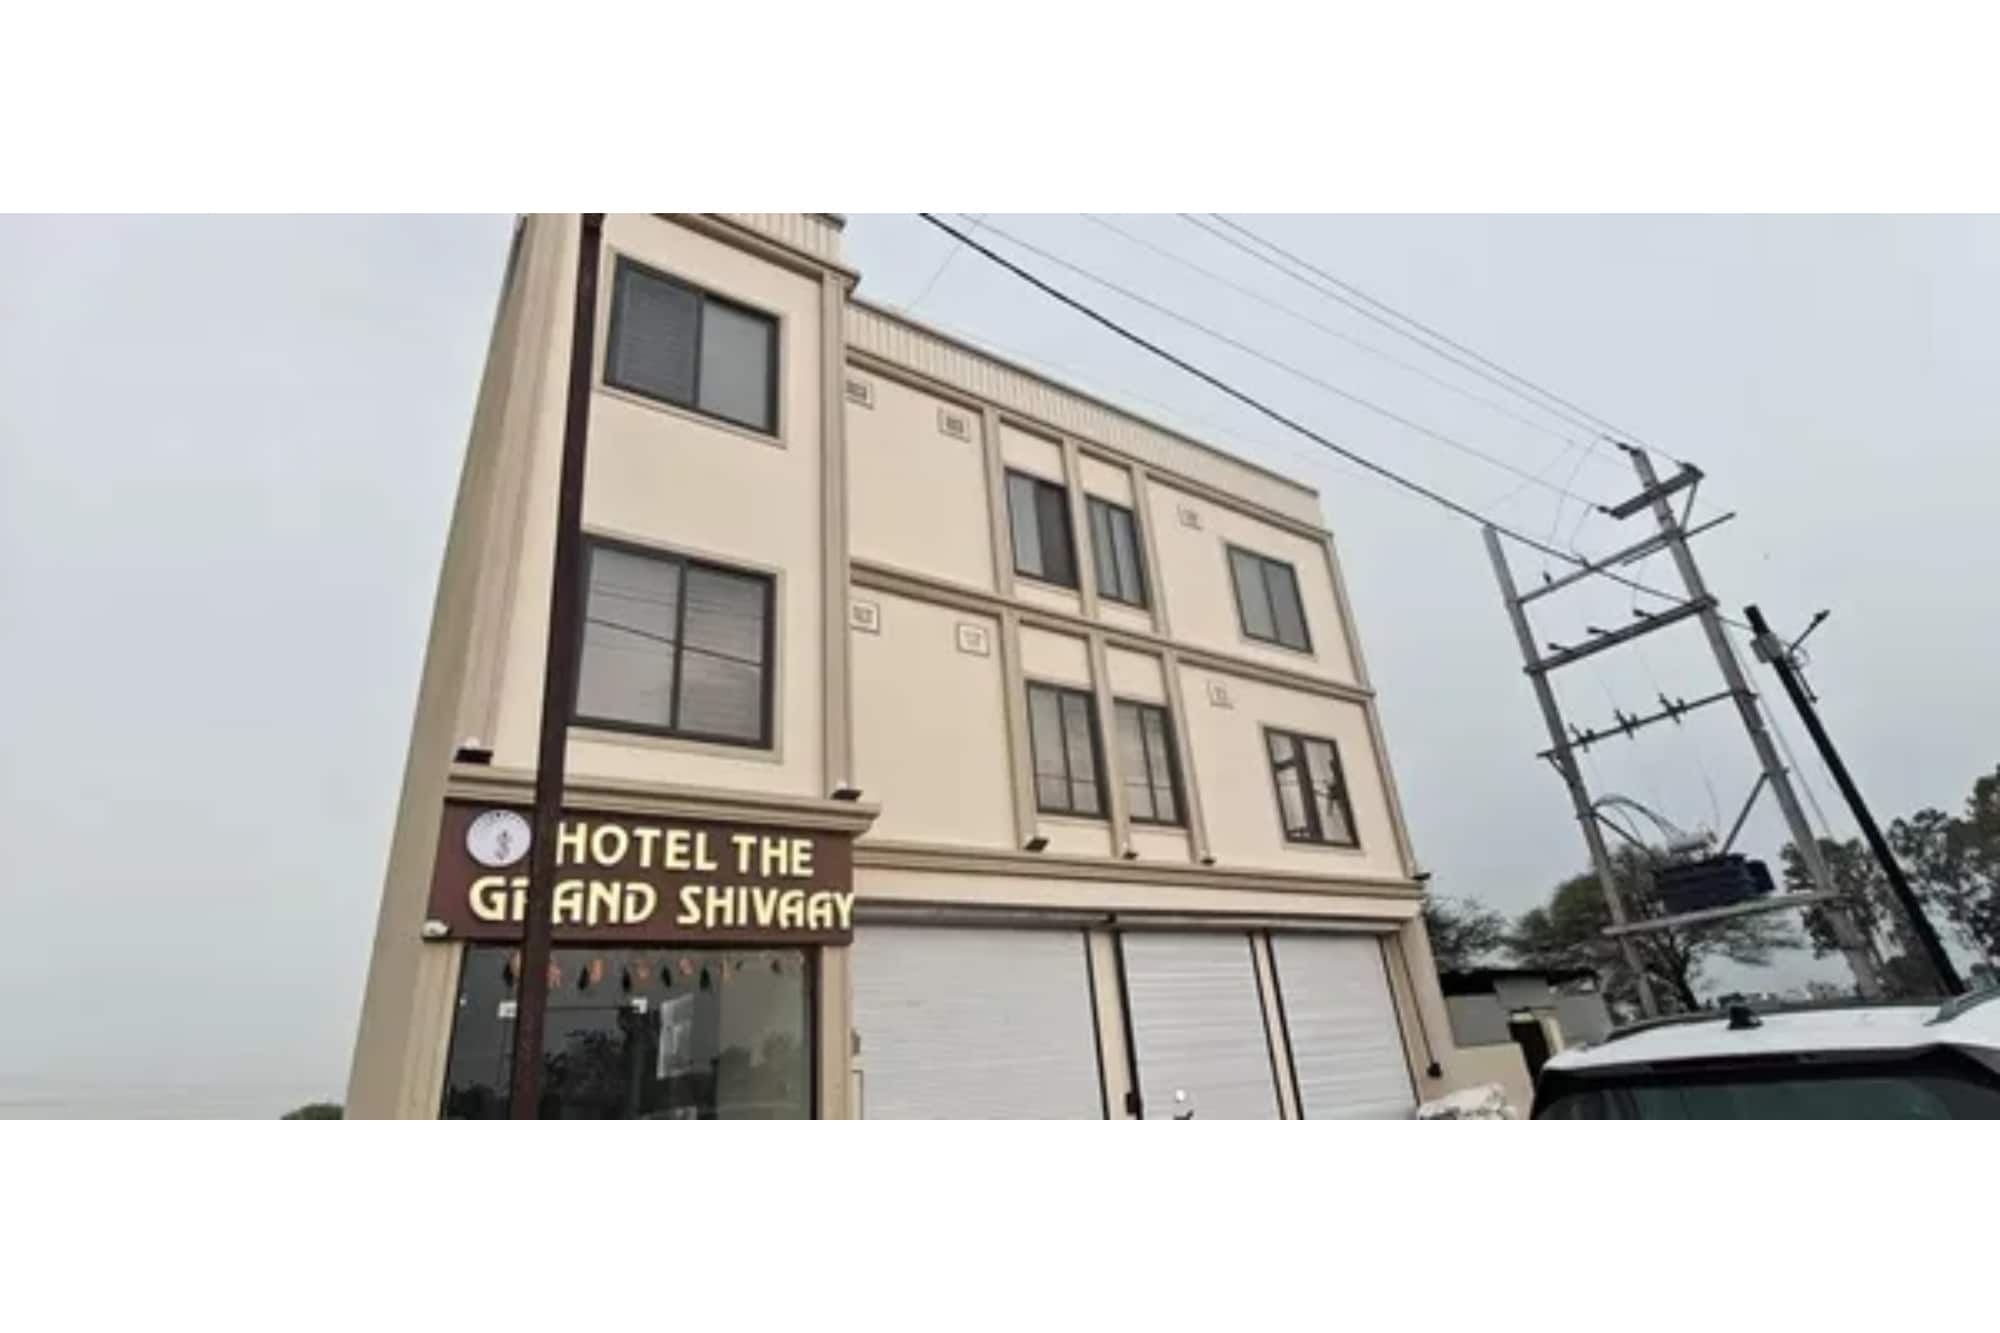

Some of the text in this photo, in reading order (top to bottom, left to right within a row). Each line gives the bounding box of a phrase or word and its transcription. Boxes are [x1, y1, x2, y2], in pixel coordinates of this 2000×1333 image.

[555, 821, 815, 878] HOTEL THE
[676, 885, 855, 931] SHIVAAY
